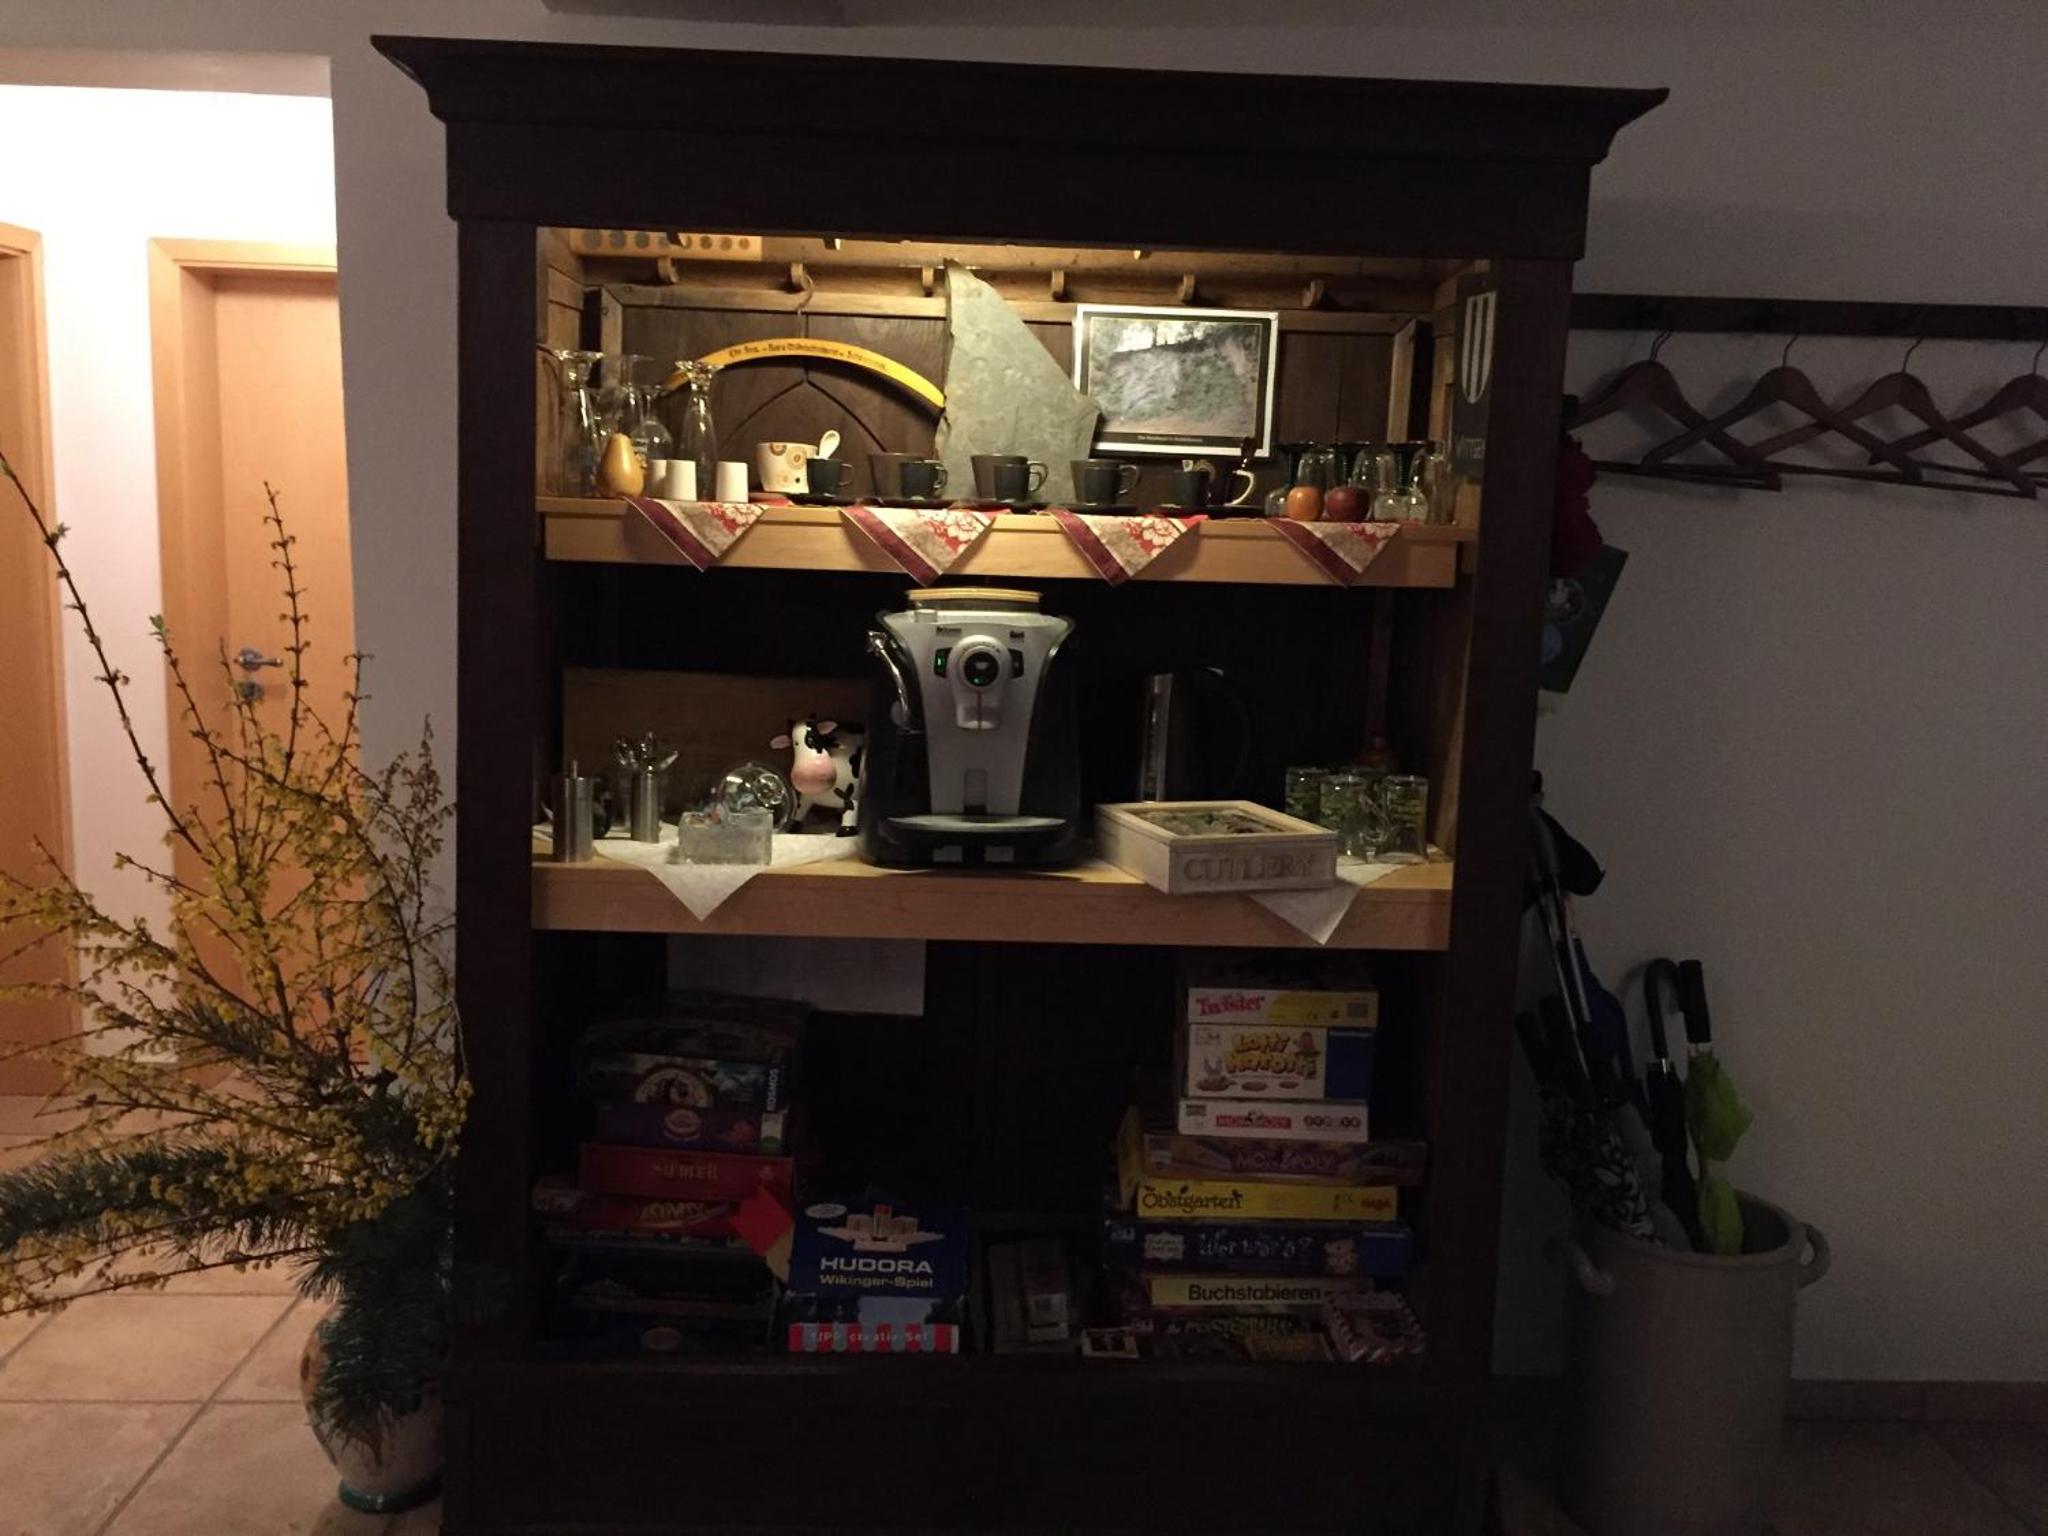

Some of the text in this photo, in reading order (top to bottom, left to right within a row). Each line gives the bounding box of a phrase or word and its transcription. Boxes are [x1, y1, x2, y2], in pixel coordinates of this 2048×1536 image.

[1183, 854, 1313, 881] CUTLERY
[766, 1068, 780, 1111] KOSMOS
[819, 1257, 934, 1274] HUDORA
[818, 1274, 934, 1289] Wikinger-Spiel
[1188, 1283, 1321, 1301] Buchstabieren
